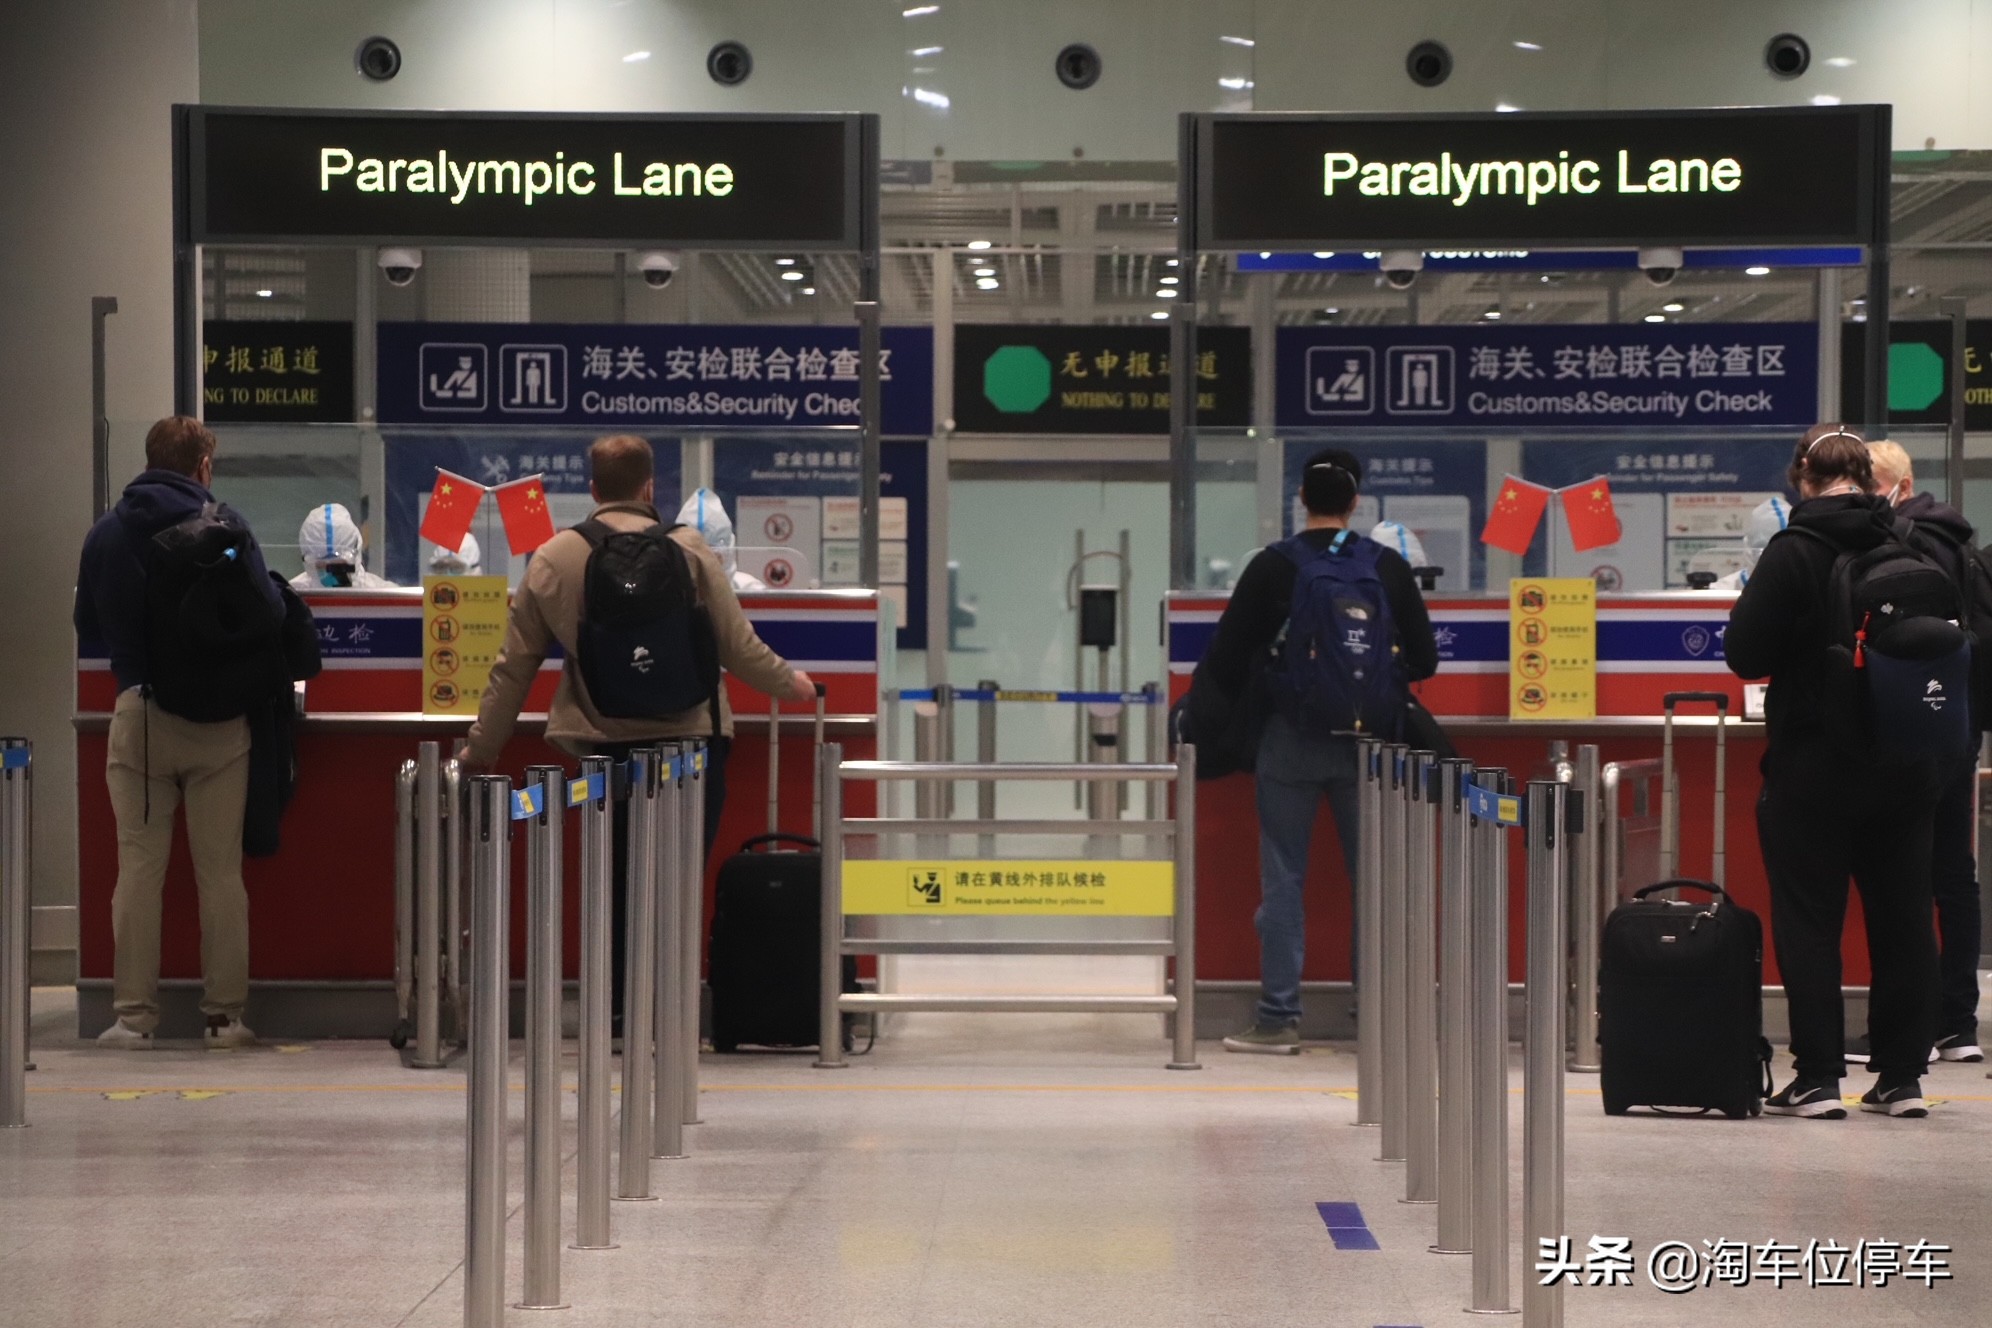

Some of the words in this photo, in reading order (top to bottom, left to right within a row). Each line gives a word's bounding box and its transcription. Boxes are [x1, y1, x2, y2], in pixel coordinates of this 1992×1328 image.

[319, 147, 596, 205] Paralympic
[613, 152, 734, 197] Lane
[1323, 150, 1601, 205] Paralympic
[1617, 150, 1743, 194] Lane
[1469, 344, 1786, 380] 海关、安检联合检查区
[231, 387, 249, 404] TO
[255, 387, 319, 405] DECLARE
[582, 391, 798, 420] Customs&Security
[804, 392, 861, 415] Chec
[1062, 391, 1124, 409] NOTHING
[1130, 391, 1149, 409] TO
[1153, 391, 1216, 409] DERE
[1468, 391, 1688, 418] Customs&Security
[1695, 390, 1772, 412] Check
[955, 871, 1106, 887] 请在黄线外排队候检
[955, 896, 982, 905] Please
